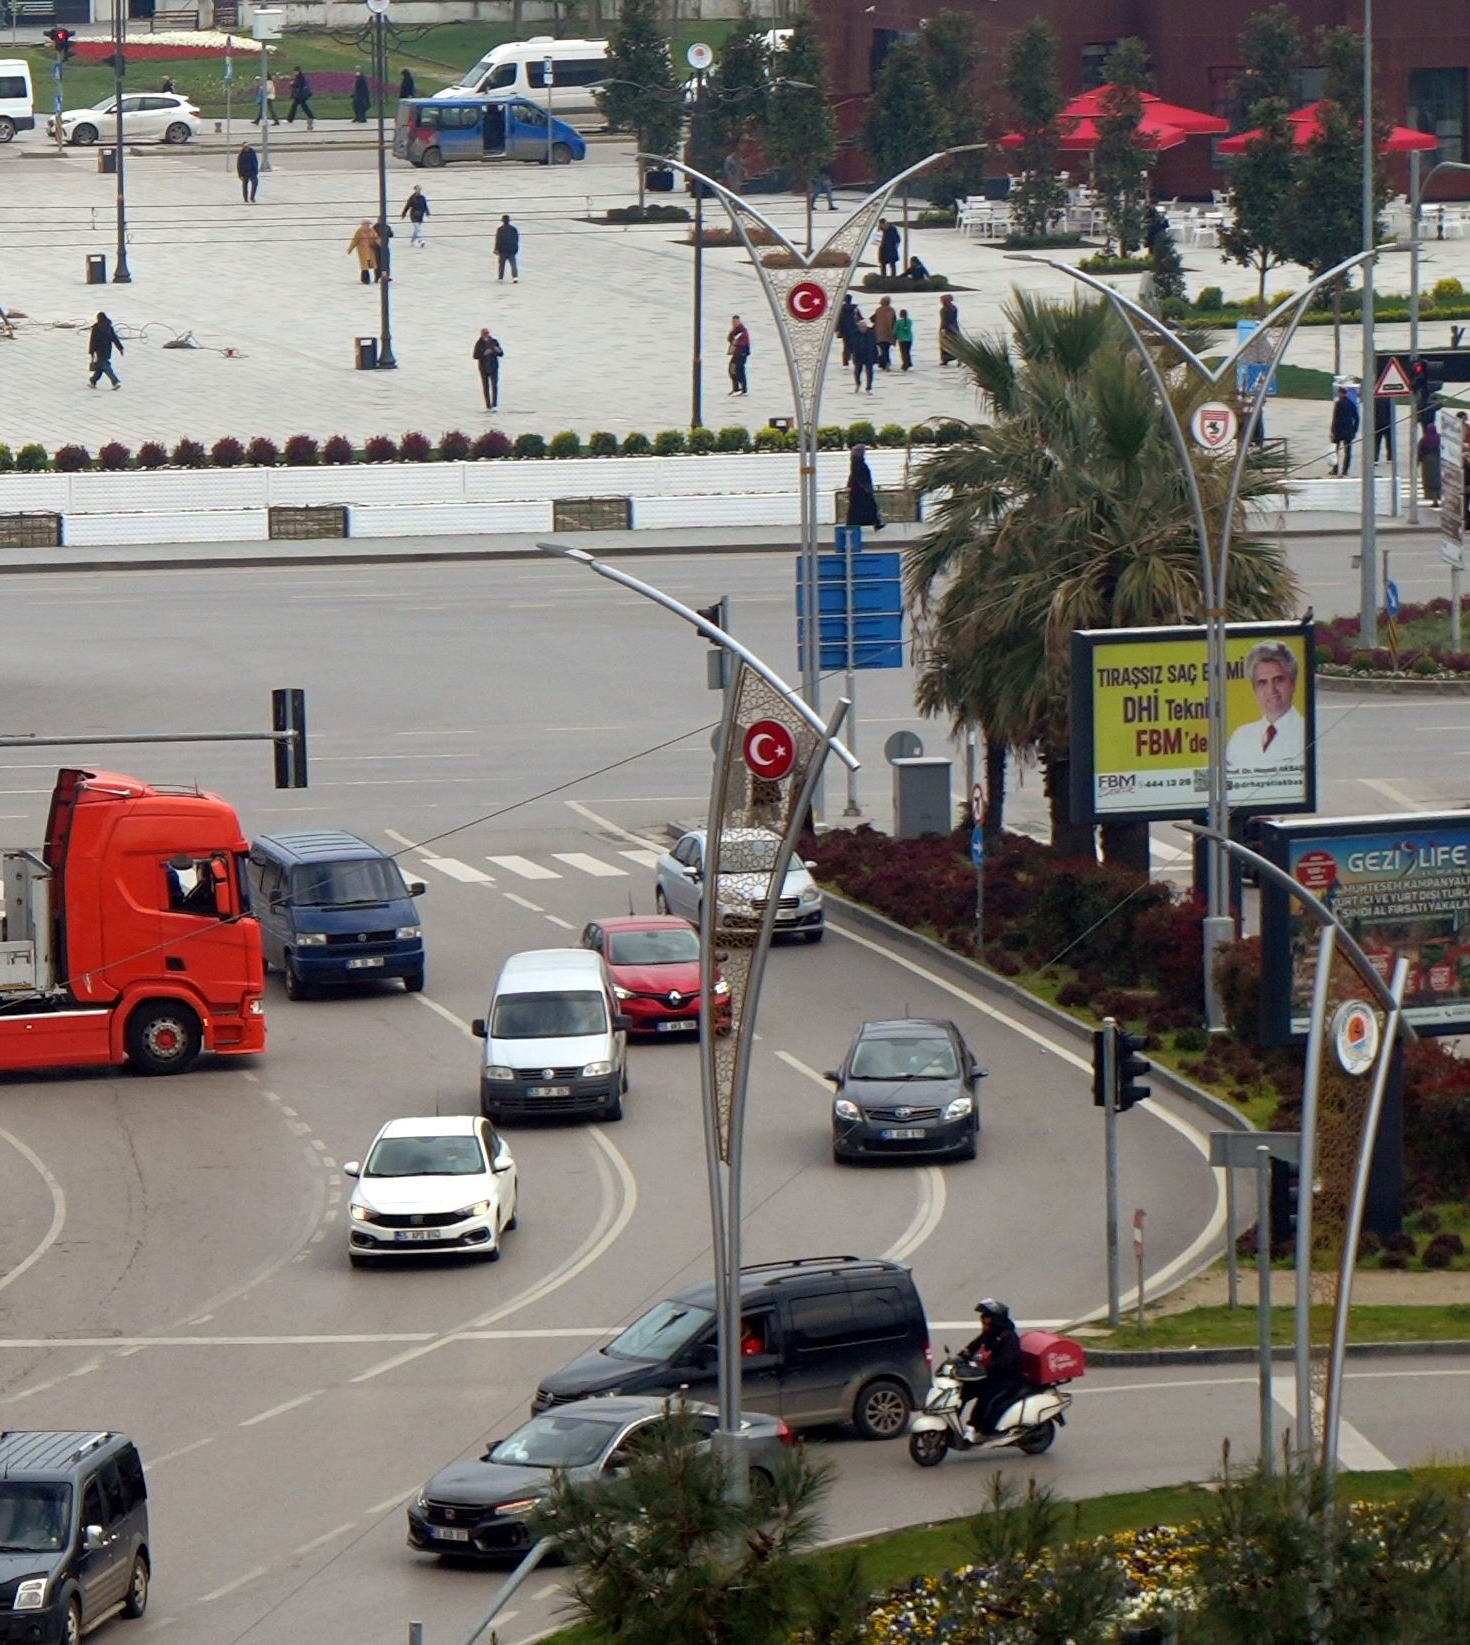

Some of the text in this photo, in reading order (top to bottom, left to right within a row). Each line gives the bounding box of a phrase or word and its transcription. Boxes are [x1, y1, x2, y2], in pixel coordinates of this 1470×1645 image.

[1097, 664, 1163, 688] TIRAŞSIZ
[1167, 663, 1197, 686] SAÇ
[1098, 774, 1136, 788] FBM
